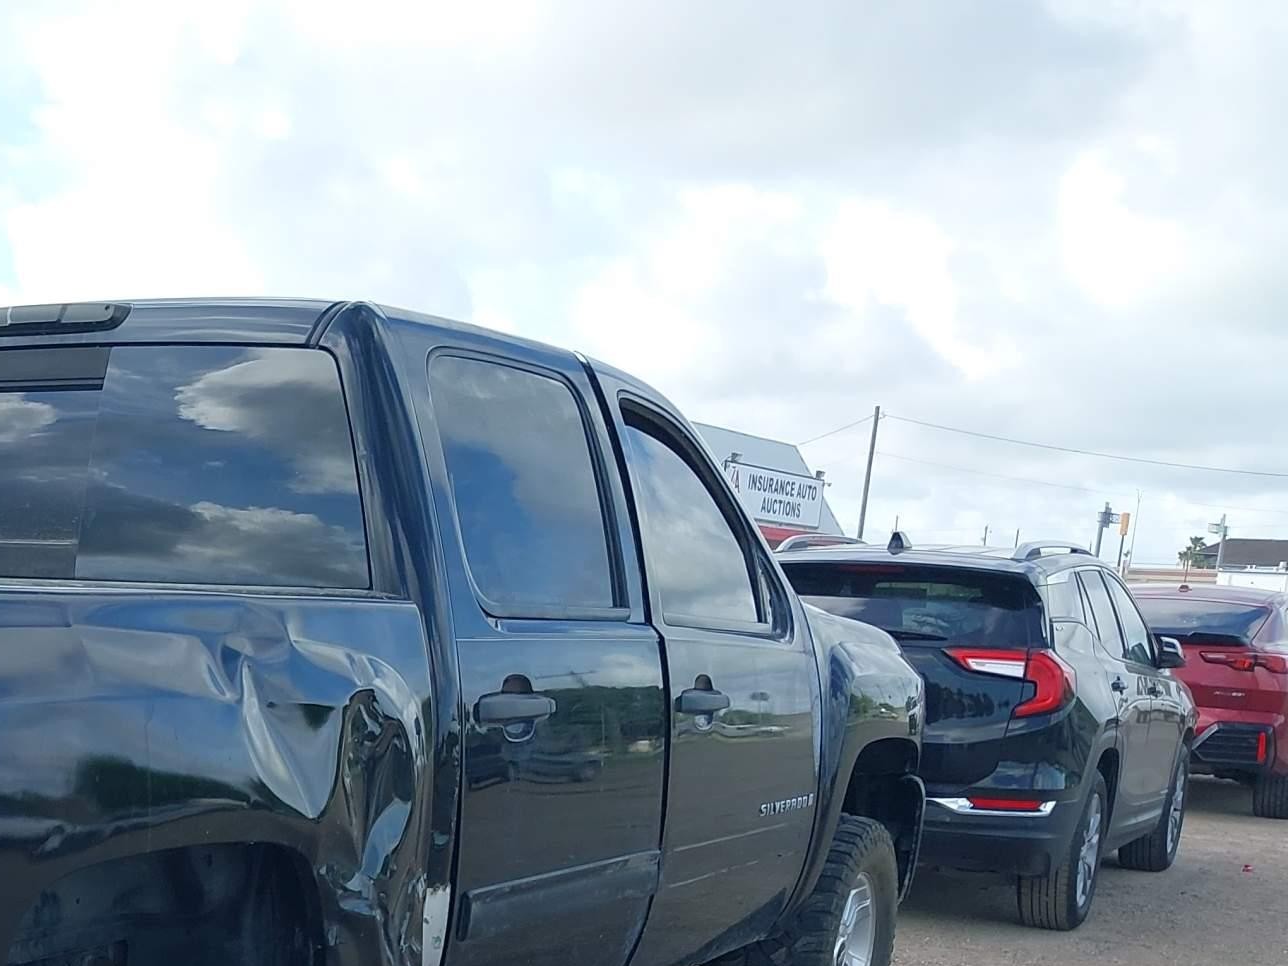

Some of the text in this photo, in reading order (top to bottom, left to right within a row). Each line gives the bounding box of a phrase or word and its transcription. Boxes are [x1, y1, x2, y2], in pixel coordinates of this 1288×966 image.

[748, 473, 795, 498] INSURANCE
[796, 485, 817, 501] AUTO
[761, 497, 801, 518] AUCTIONS
[760, 796, 808, 816] SILVERADO
